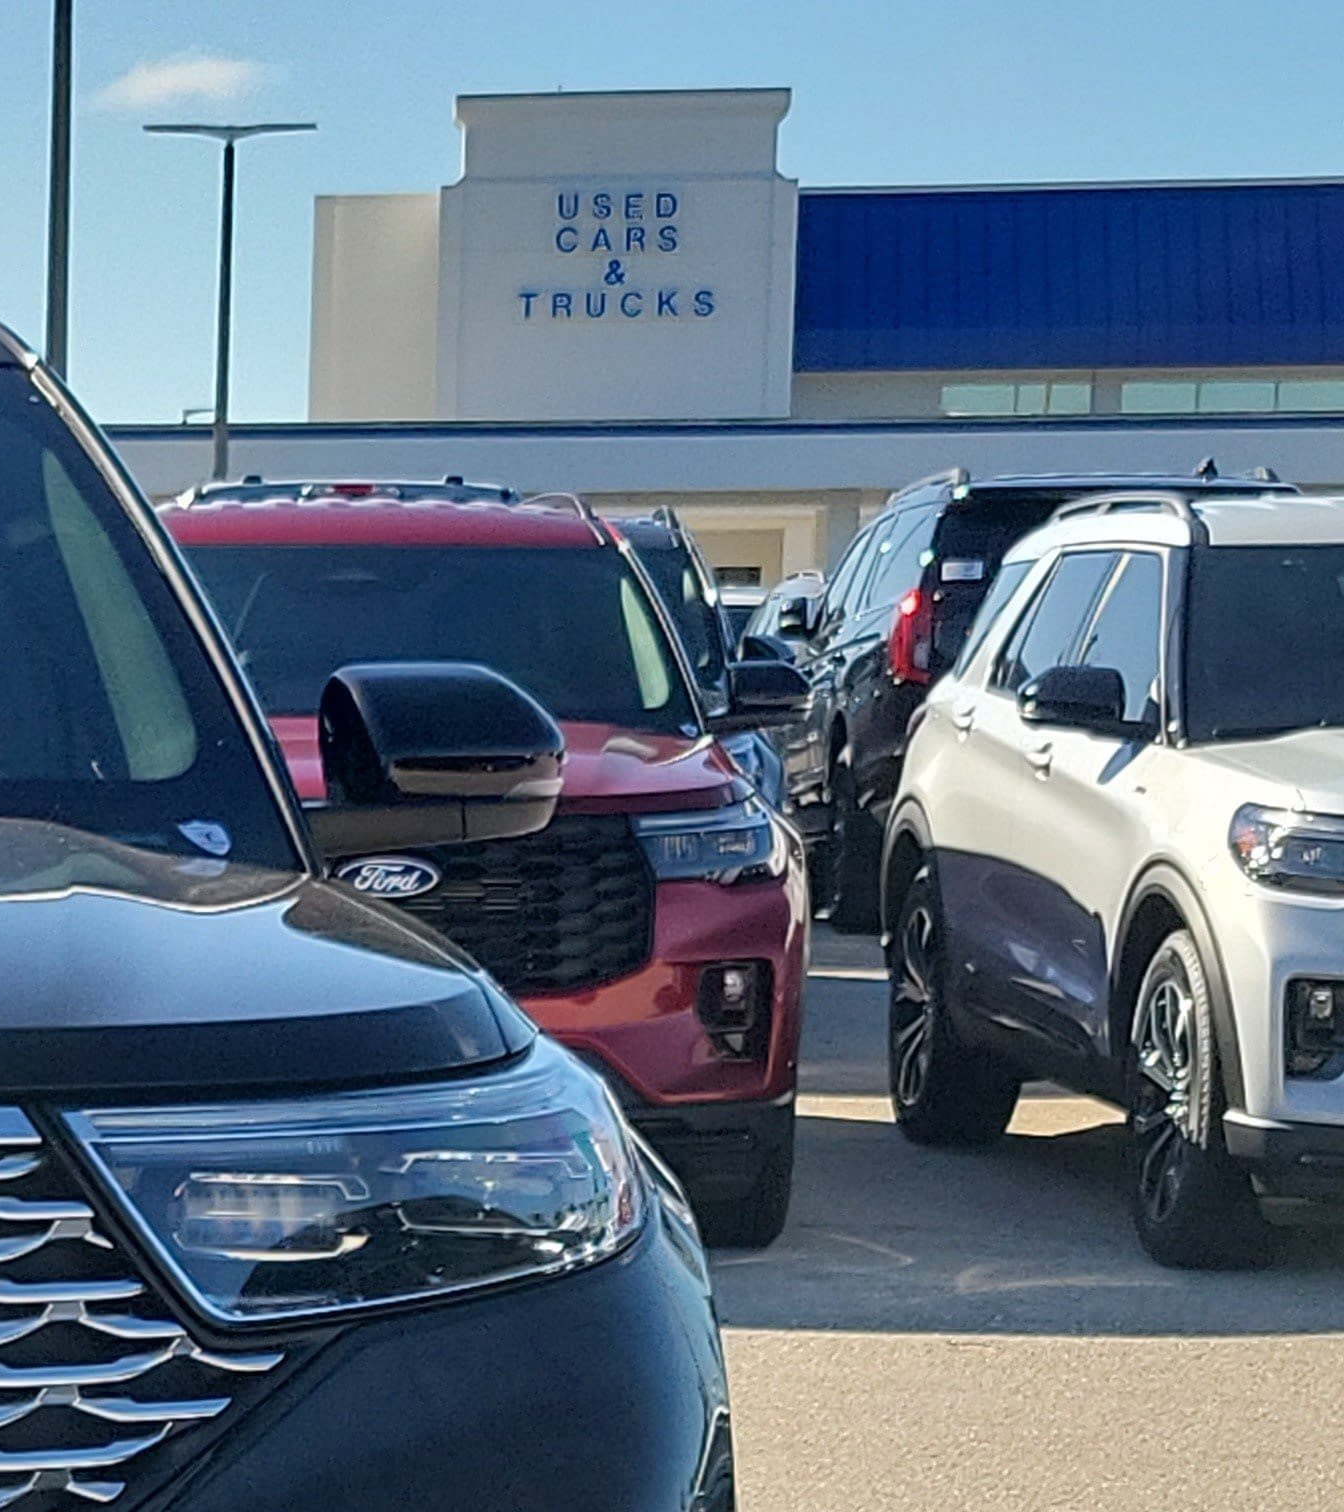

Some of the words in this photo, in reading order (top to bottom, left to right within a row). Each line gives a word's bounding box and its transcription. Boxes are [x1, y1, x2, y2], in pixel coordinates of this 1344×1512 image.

[558, 193, 678, 219] USED
[556, 226, 678, 253] CARS
[604, 259, 625, 285] &
[519, 291, 715, 318] TRUCKS
[354, 864, 422, 891] Ford
